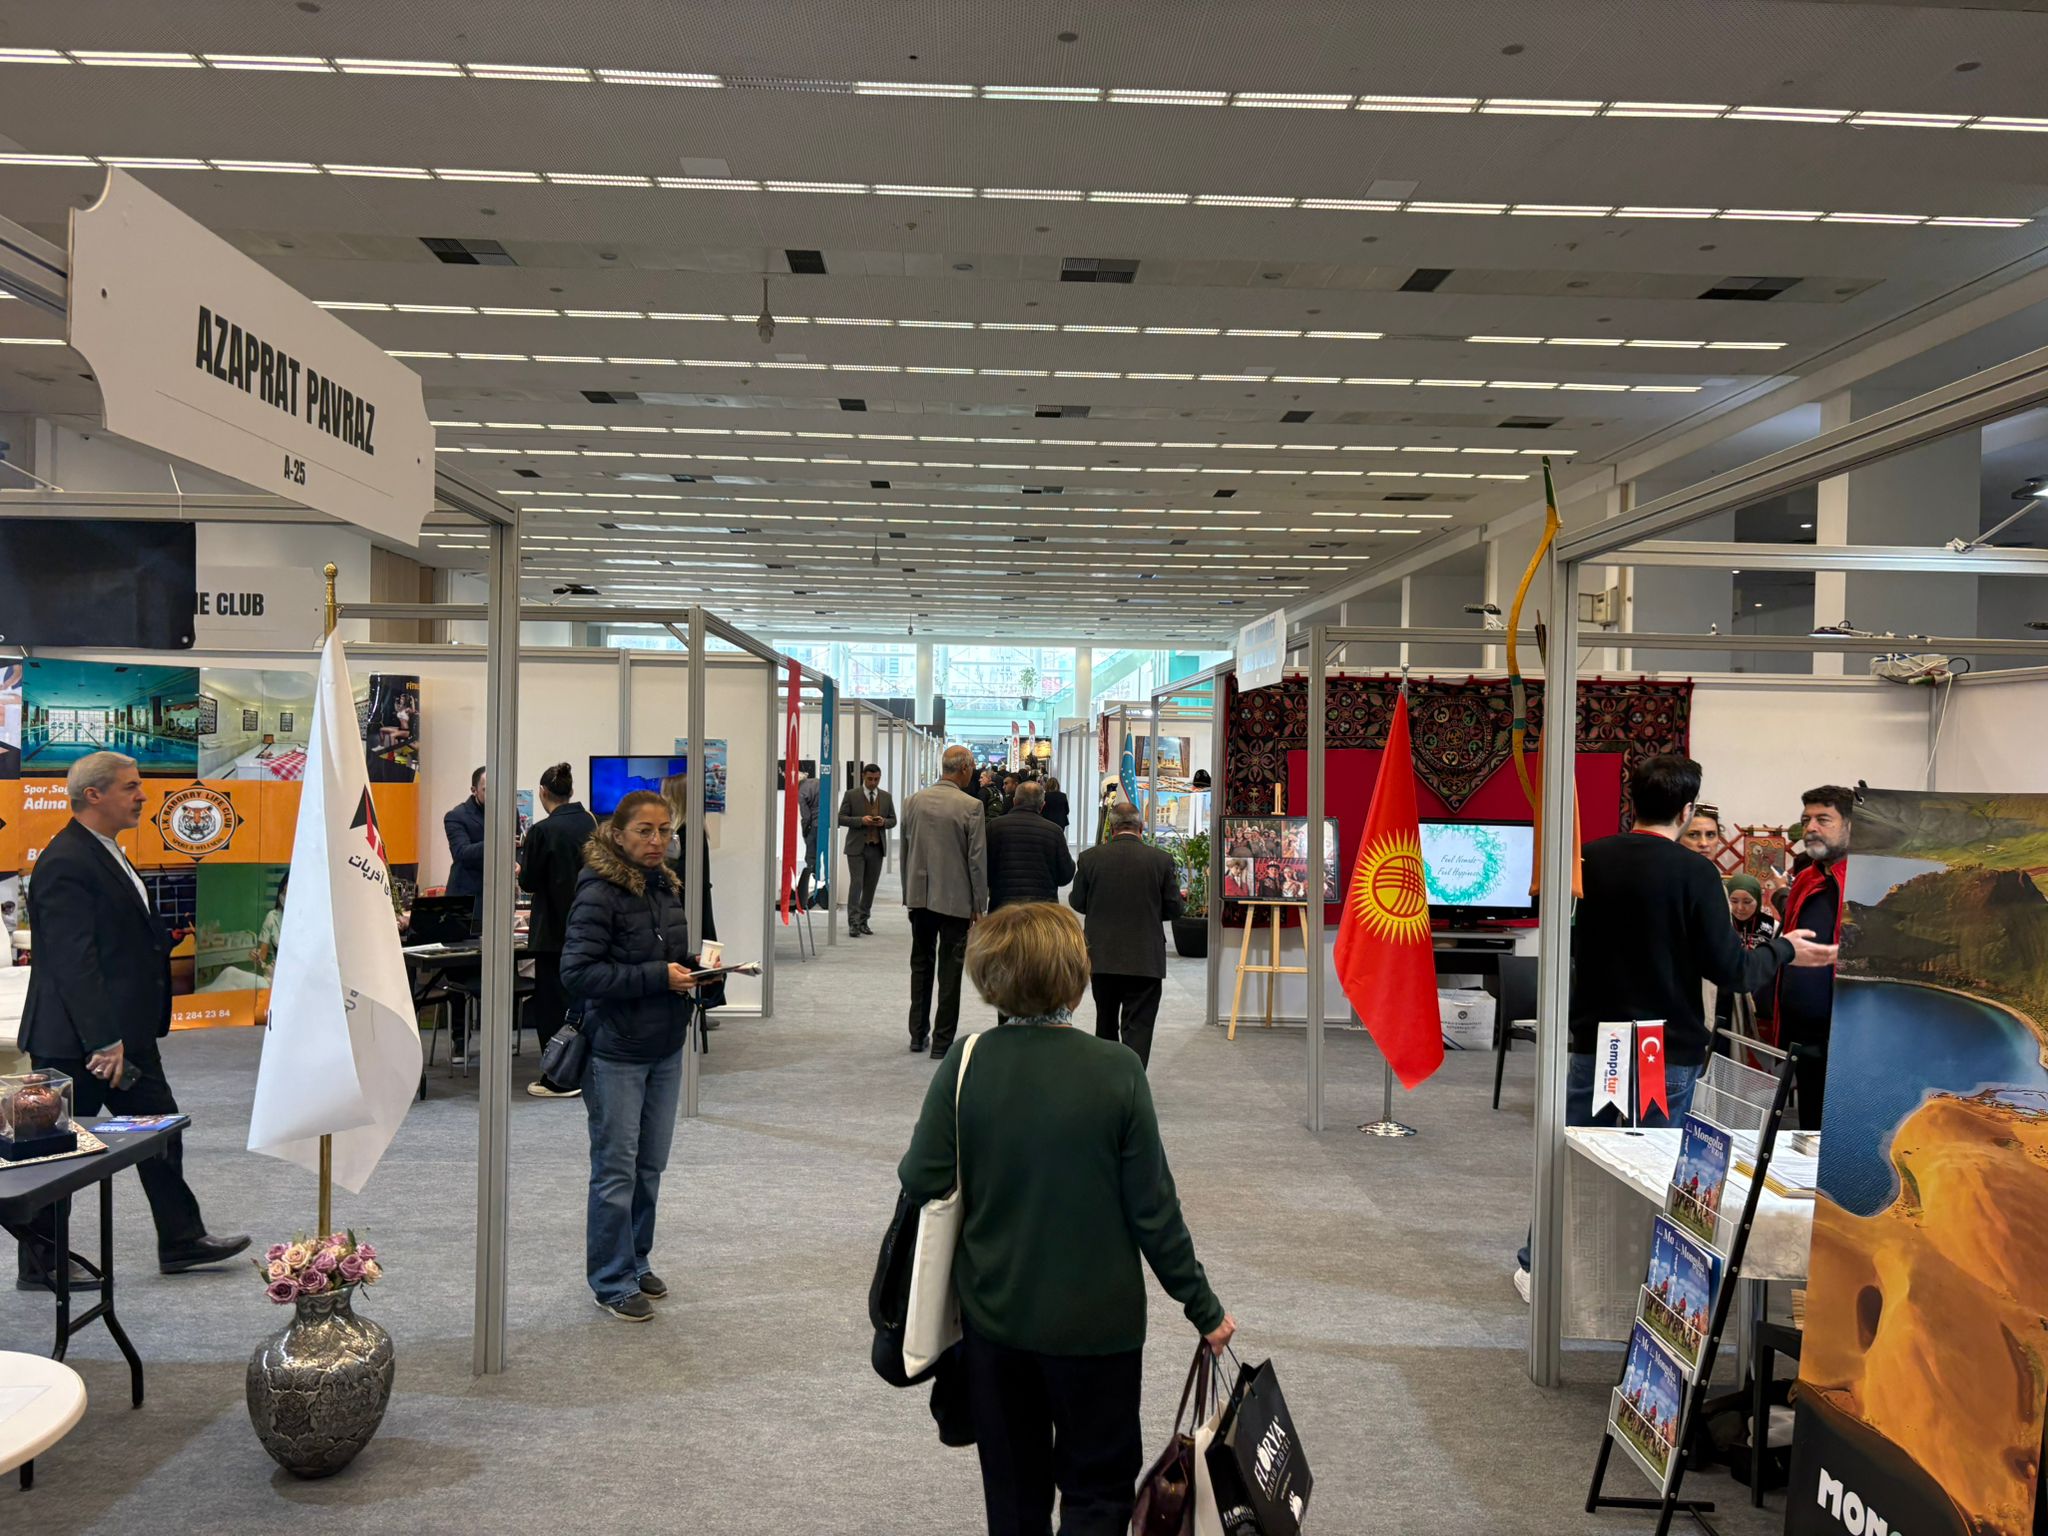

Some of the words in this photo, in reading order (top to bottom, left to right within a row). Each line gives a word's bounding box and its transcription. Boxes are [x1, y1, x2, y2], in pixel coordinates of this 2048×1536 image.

[196, 305, 300, 417] AZAPRAT
[307, 368, 375, 456] PAVRAZ
[284, 454, 306, 486] A-25
[216, 592, 264, 616] CLUB
[23, 797, 67, 810] Adına
[24, 784, 48, 795] Spor
[205, 793, 224, 807] LIFE
[222, 807, 233, 829] CLUB
[172, 1012, 183, 1021] 12
[1817, 1467, 1903, 1536] MON
